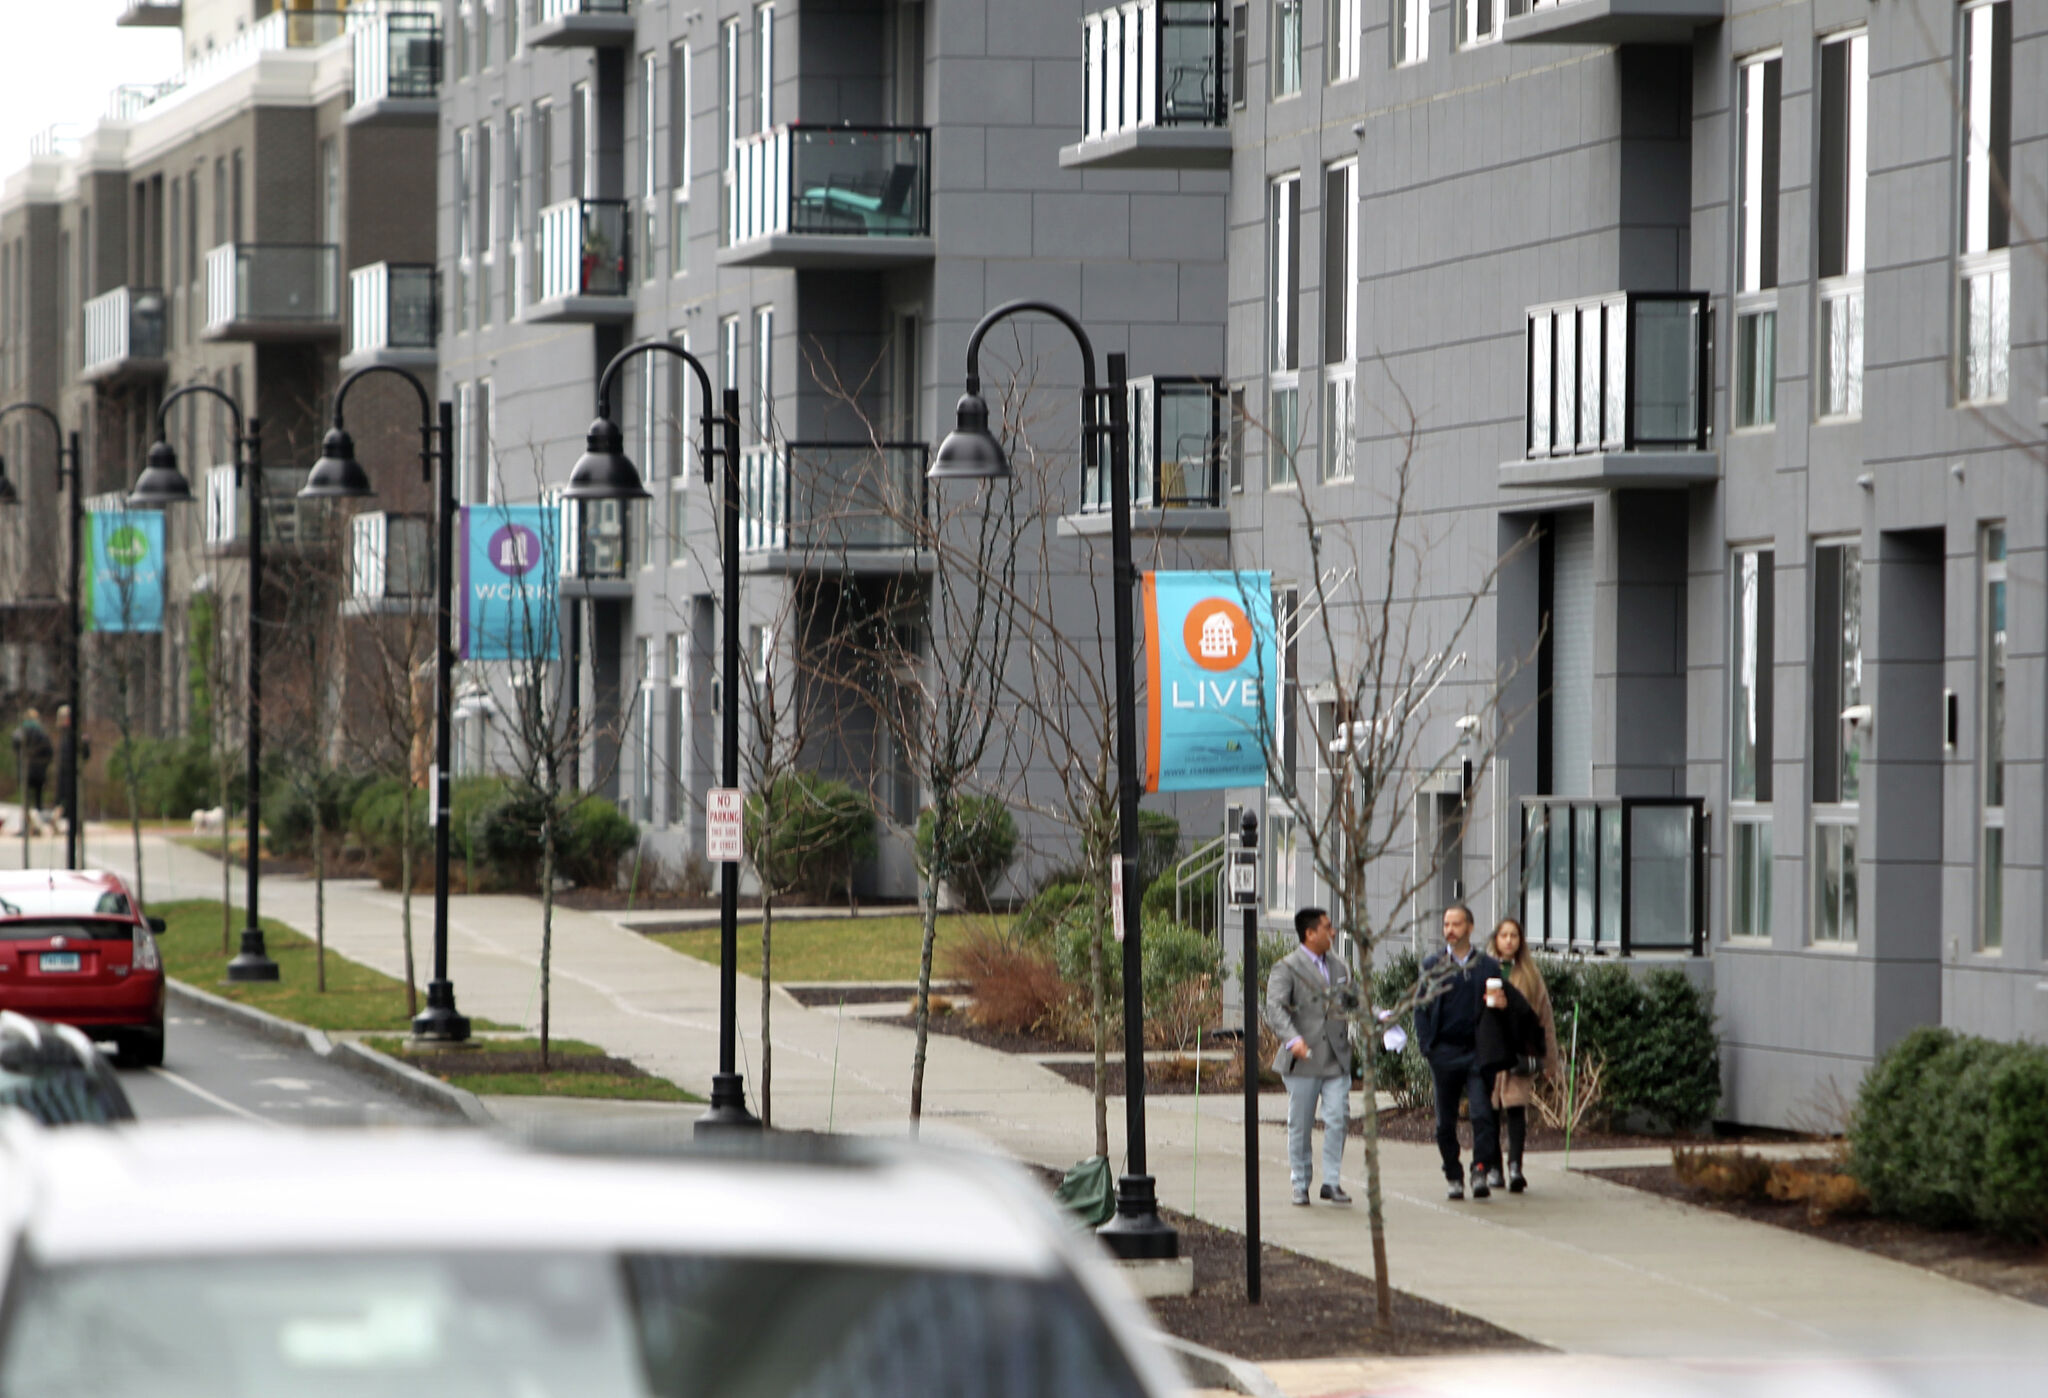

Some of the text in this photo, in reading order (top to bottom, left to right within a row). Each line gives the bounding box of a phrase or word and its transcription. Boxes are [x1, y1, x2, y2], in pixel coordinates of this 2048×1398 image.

[475, 584, 553, 600] WORK
[1172, 680, 1261, 708] LIVE
[717, 795, 731, 808] NO
[710, 810, 740, 824] PARKING
